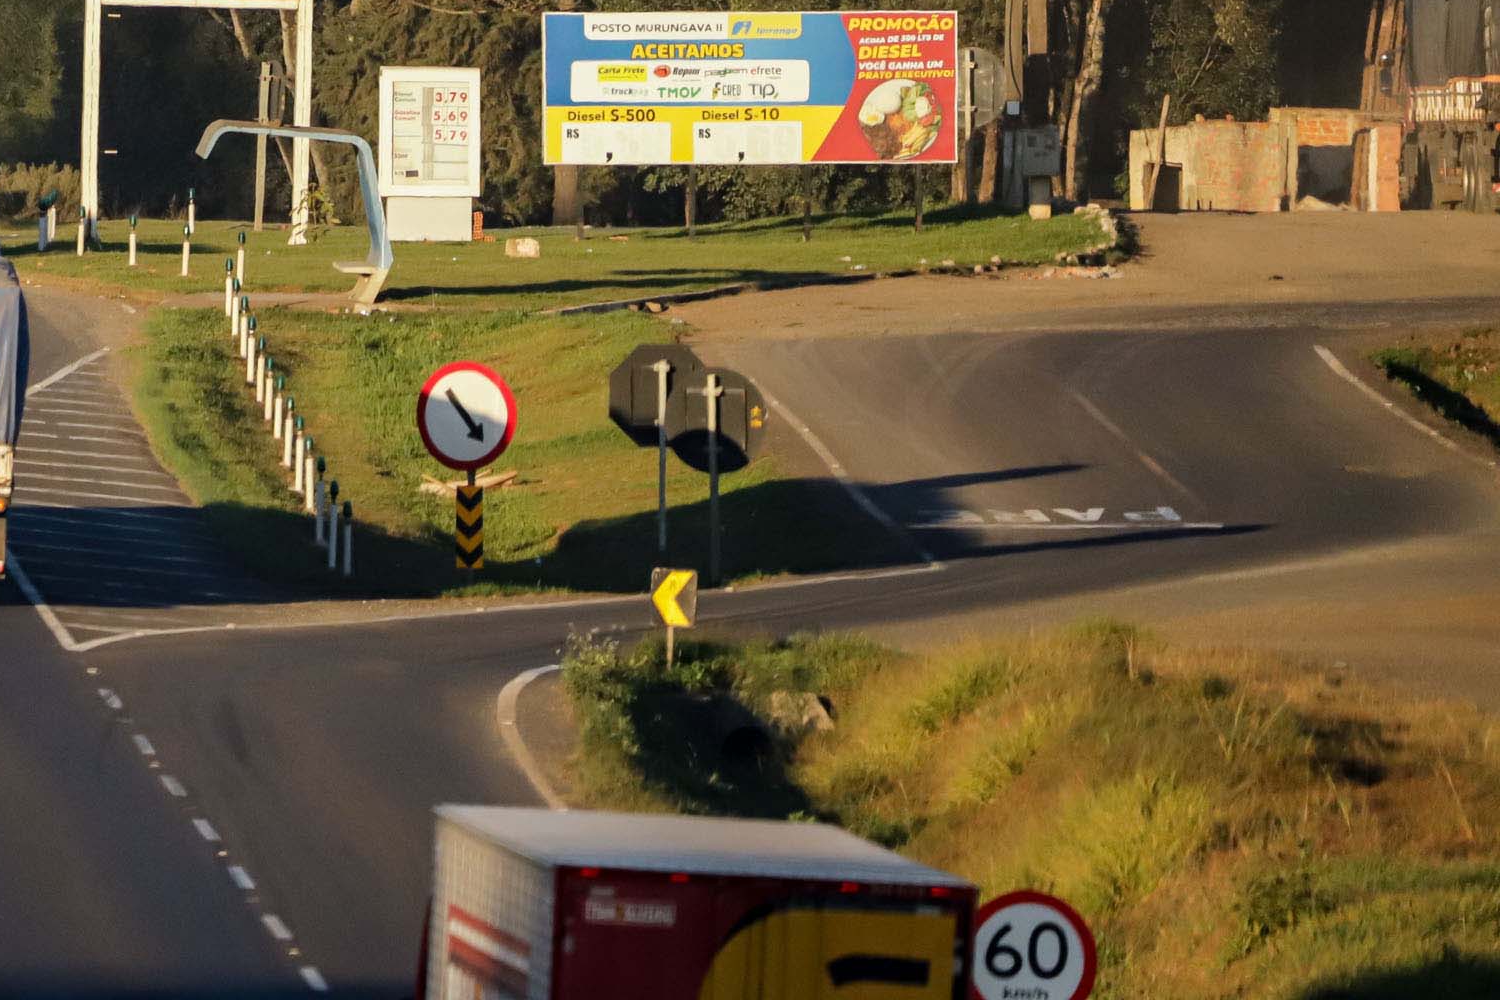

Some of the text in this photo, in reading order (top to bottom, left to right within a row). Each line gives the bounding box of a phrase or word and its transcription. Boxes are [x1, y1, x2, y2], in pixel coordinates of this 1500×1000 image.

[591, 23, 632, 33] POSTO
[635, 23, 713, 33] MURUNGAVA
[848, 14, 954, 33] PROMOÇÃO
[630, 43, 745, 59] ACEITAMOS
[858, 44, 922, 60] DIESEL
[598, 66, 622, 75] Carta
[858, 60, 944, 70] VOCÊ GANHA UM
[858, 71, 893, 80] PRATO
[435, 91, 468, 103] 3,79
[657, 86, 702, 98] TMOV
[433, 111, 468, 122] 5,69
[568, 108, 656, 122] Diesel S-500
[702, 108, 780, 121] Diesel S-10
[435, 129, 468, 141] 5,79
[985, 921, 1069, 980] 60
